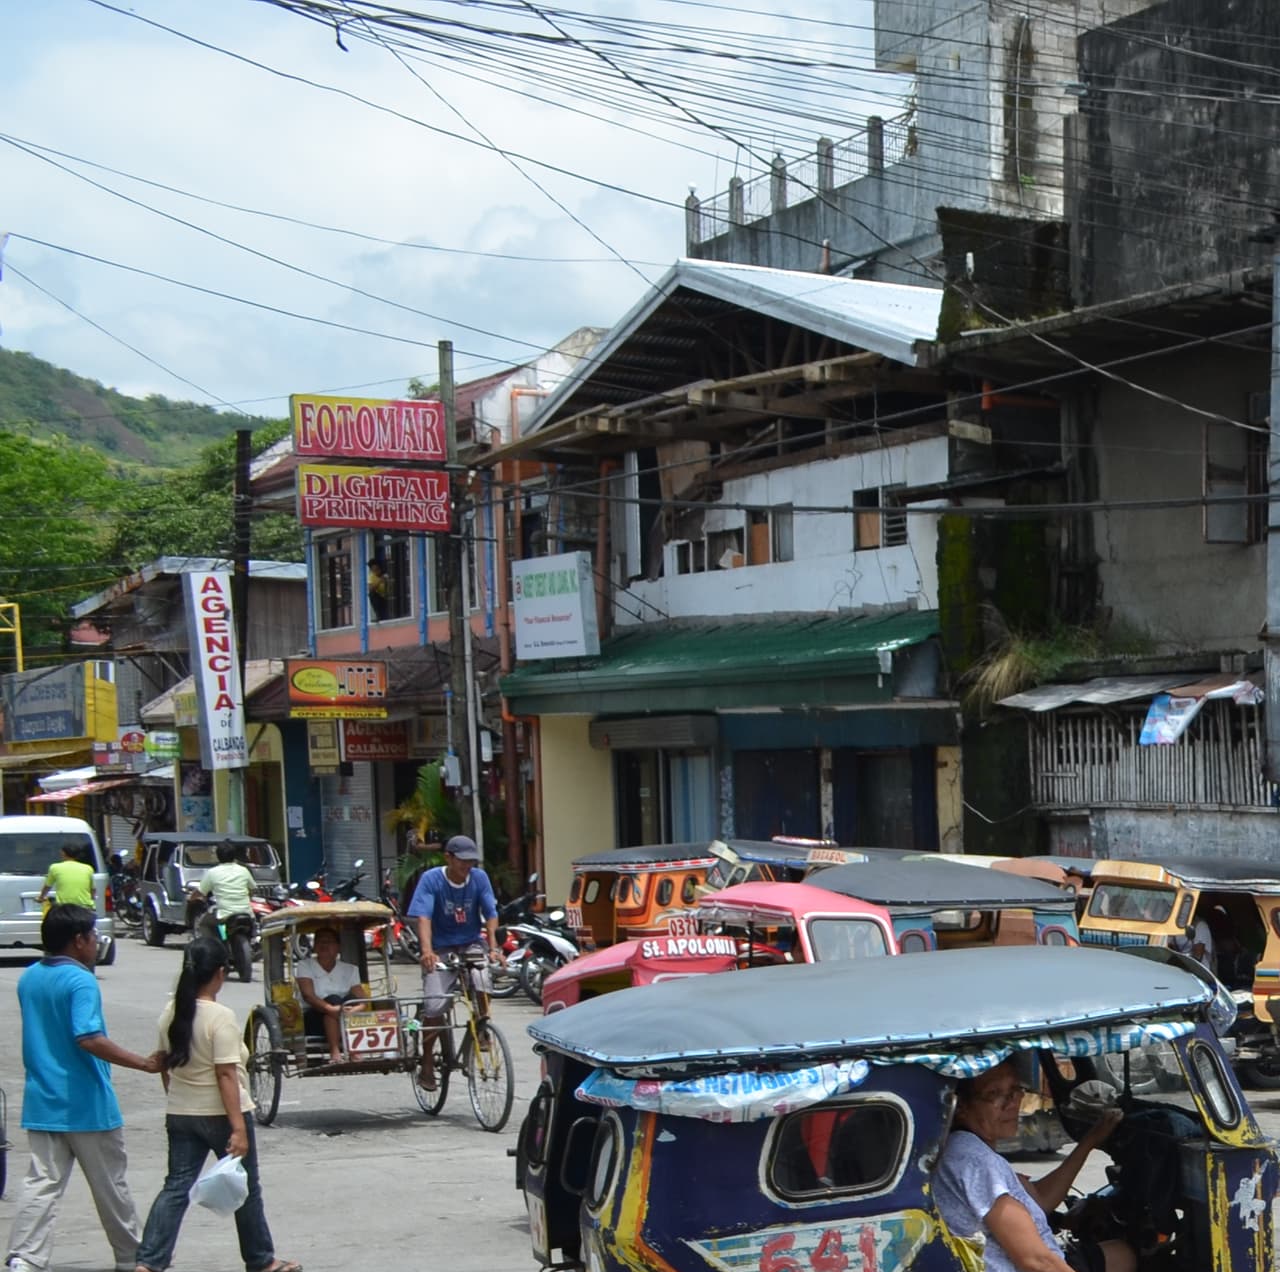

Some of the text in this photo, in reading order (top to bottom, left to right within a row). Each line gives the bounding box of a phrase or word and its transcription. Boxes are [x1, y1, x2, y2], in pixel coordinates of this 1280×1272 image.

[299, 400, 443, 455] FOTOMAR
[304, 471, 448, 503] DIGITAL
[305, 497, 449, 526] PRINTING
[199, 575, 237, 712] AGENCIA
[642, 936, 737, 958] St. APOLONIA
[349, 1026, 397, 1051] 757
